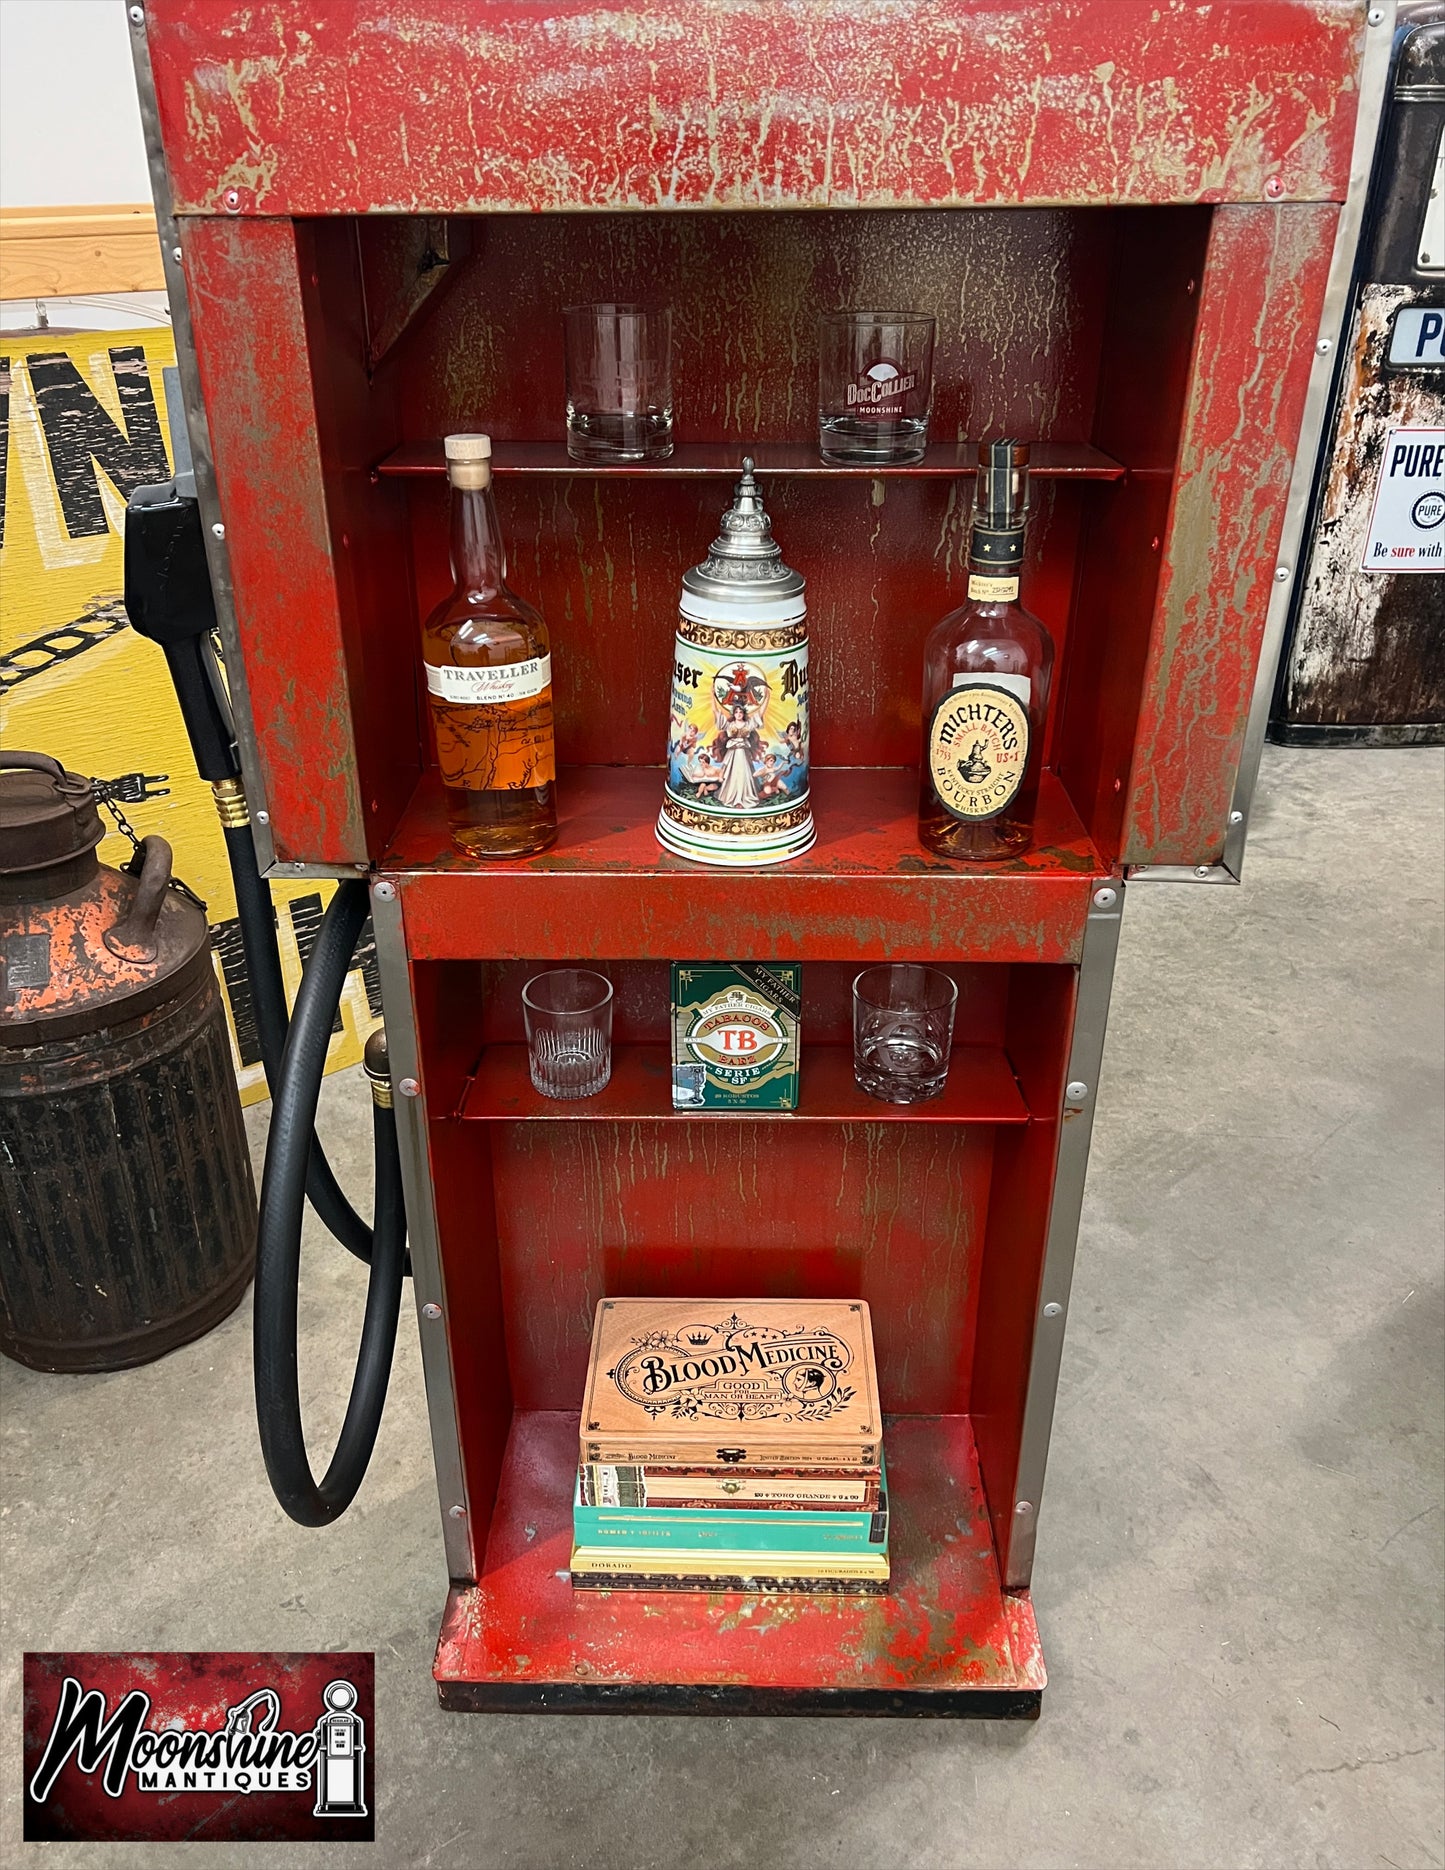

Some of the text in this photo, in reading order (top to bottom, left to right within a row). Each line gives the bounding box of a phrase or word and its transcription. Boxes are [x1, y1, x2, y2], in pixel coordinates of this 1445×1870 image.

[1416, 312, 1445, 357] P
[859, 406, 902, 414] MOONSHINE
[1389, 445, 1444, 477] PURE
[1417, 504, 1443, 516] PURE
[1373, 540, 1442, 558] Be sure with
[443, 662, 539, 681] TRAVELLER
[674, 659, 703, 689] ser
[779, 658, 809, 702] Bu
[953, 722, 1001, 751] SMALL BATCH
[937, 767, 1016, 807] BOURBON
[754, 967, 766, 979] MY
[767, 976, 796, 1003] FATHER
[754, 979, 784, 1003] CIGARS
[745, 1004, 771, 1016] CIGARS
[704, 1014, 770, 1031] TABACOS
[717, 1030, 758, 1051] TB
[714, 1067, 760, 1077] SERIE
[731, 1077, 748, 1085] SF
[640, 1342, 842, 1396] BLOOD MEDICINE
[723, 1382, 760, 1390] GOOD
[628, 1452, 646, 1460] BLOOD
